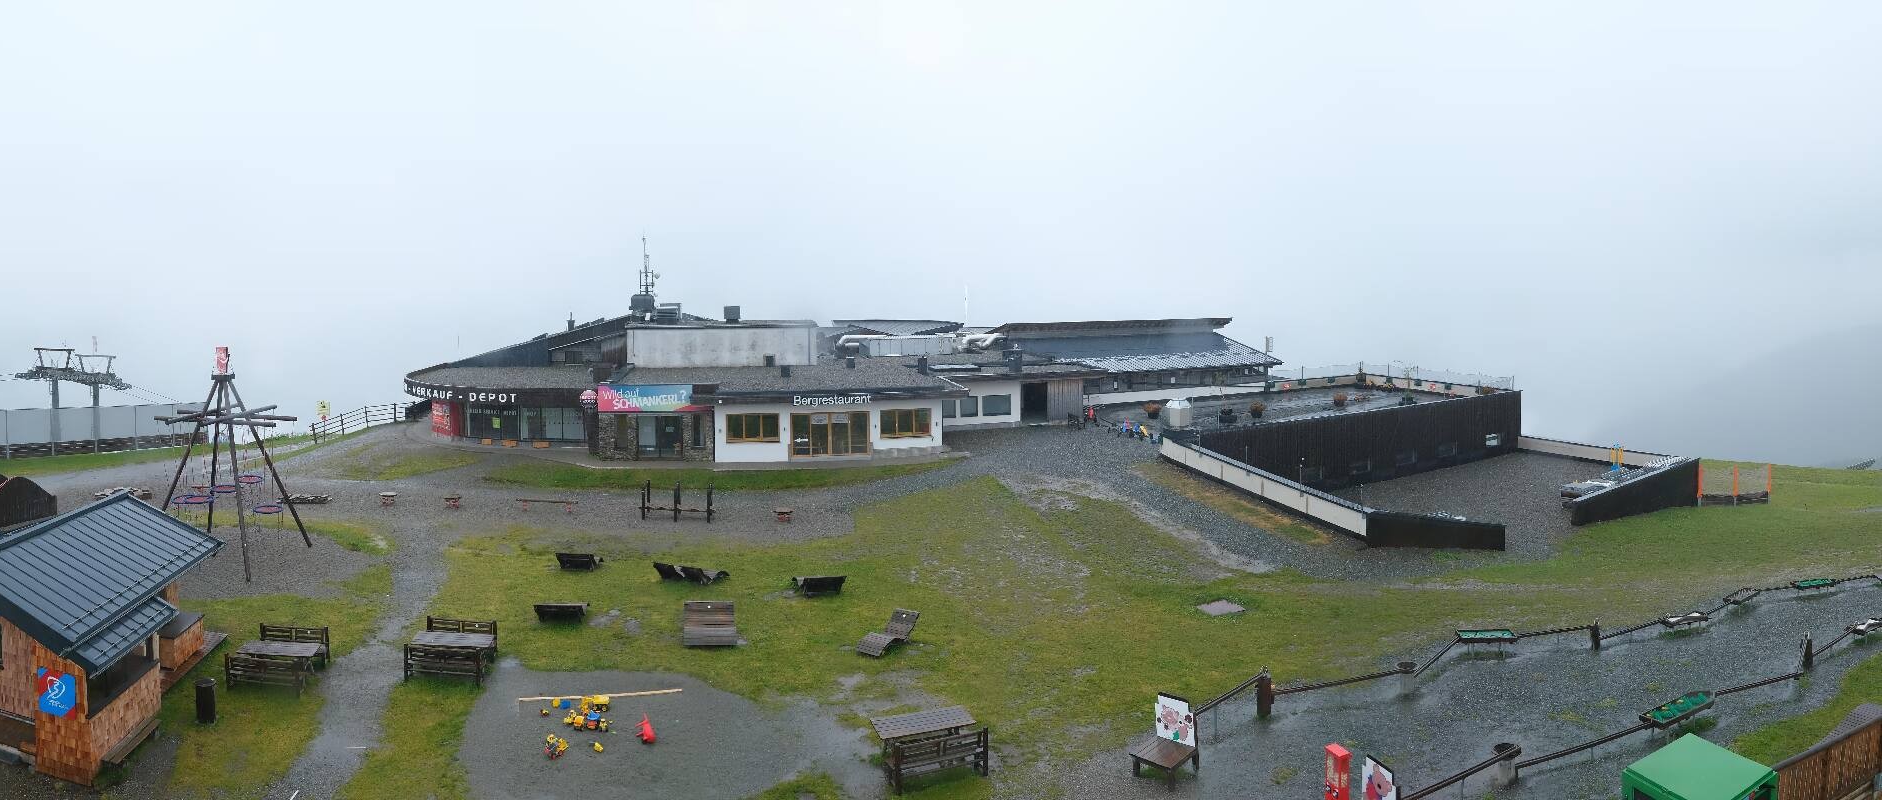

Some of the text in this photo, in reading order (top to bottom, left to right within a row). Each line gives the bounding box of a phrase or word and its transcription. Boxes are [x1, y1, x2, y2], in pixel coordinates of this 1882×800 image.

[412, 385, 453, 400] VERKAUF
[469, 392, 517, 403] DEPOT
[602, 388, 623, 400] Wild
[624, 387, 640, 398] auf
[612, 390, 687, 410] SCHMANKERL?
[793, 393, 872, 408] Bergrestaurant
